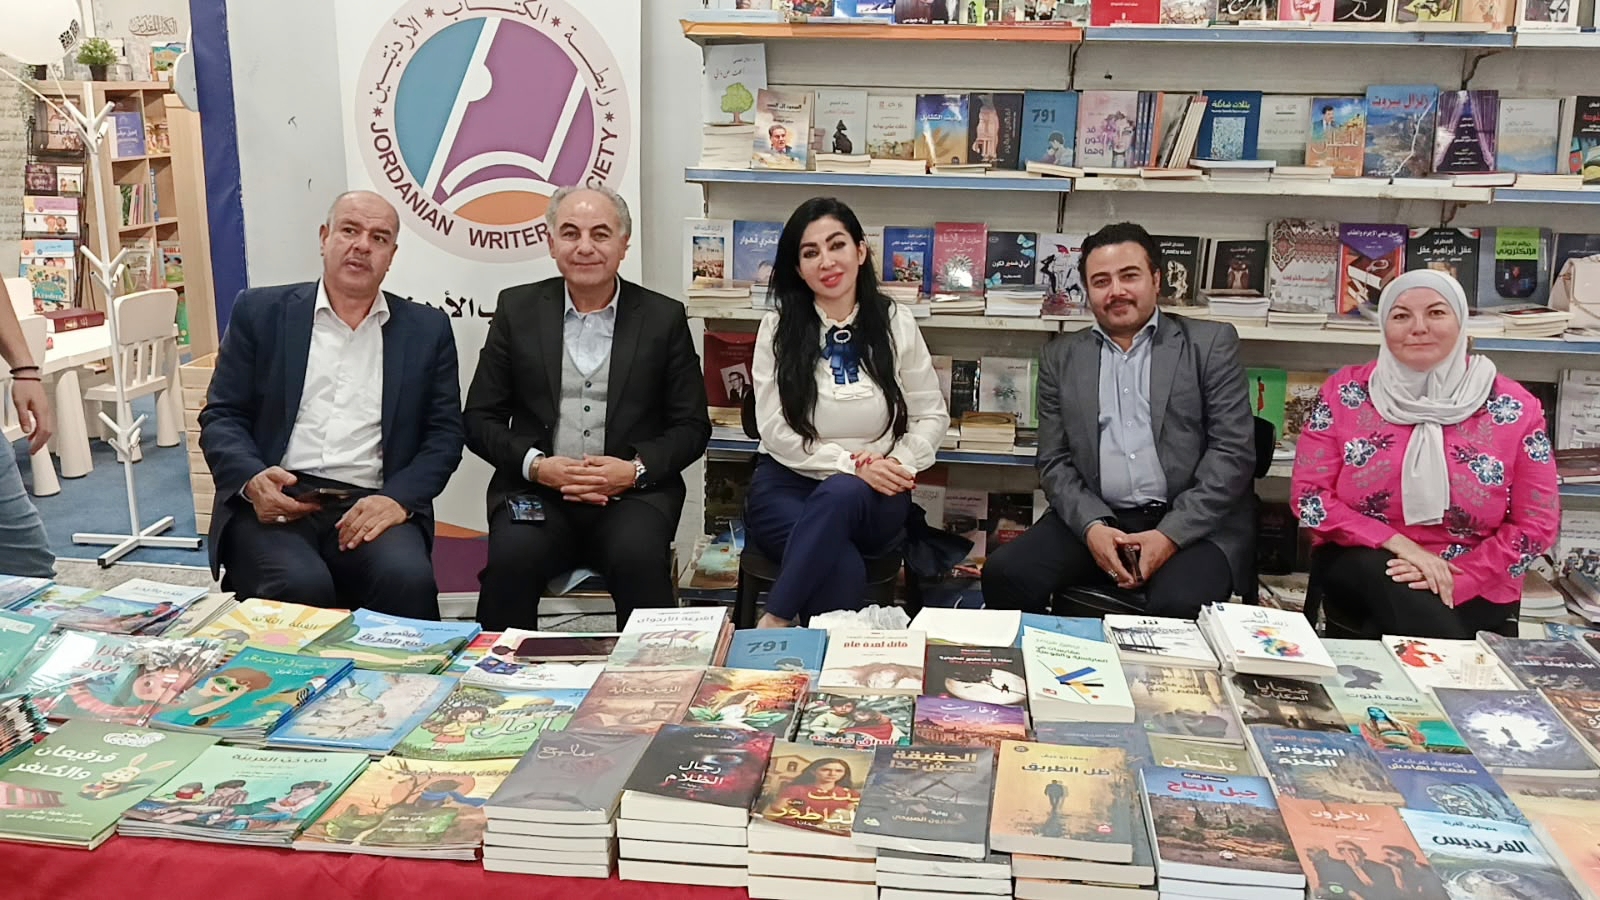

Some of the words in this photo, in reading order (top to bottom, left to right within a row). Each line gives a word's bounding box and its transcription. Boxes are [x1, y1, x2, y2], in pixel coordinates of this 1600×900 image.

[563, 25, 618, 106] رابطة
[1032, 108, 1056, 123] 791
[585, 127, 618, 189] CIETY
[370, 121, 455, 236] JORDANIAN
[468, 222, 550, 249] WRITER
[747, 640, 788, 654] 791
[892, 749, 977, 763] الحقيقة
[678, 760, 722, 775] رجال
[1021, 763, 1079, 774] الطريق
[665, 772, 725, 786] الظلام
[1168, 781, 1214, 793] التاج
[1218, 786, 1258, 798] جبل
